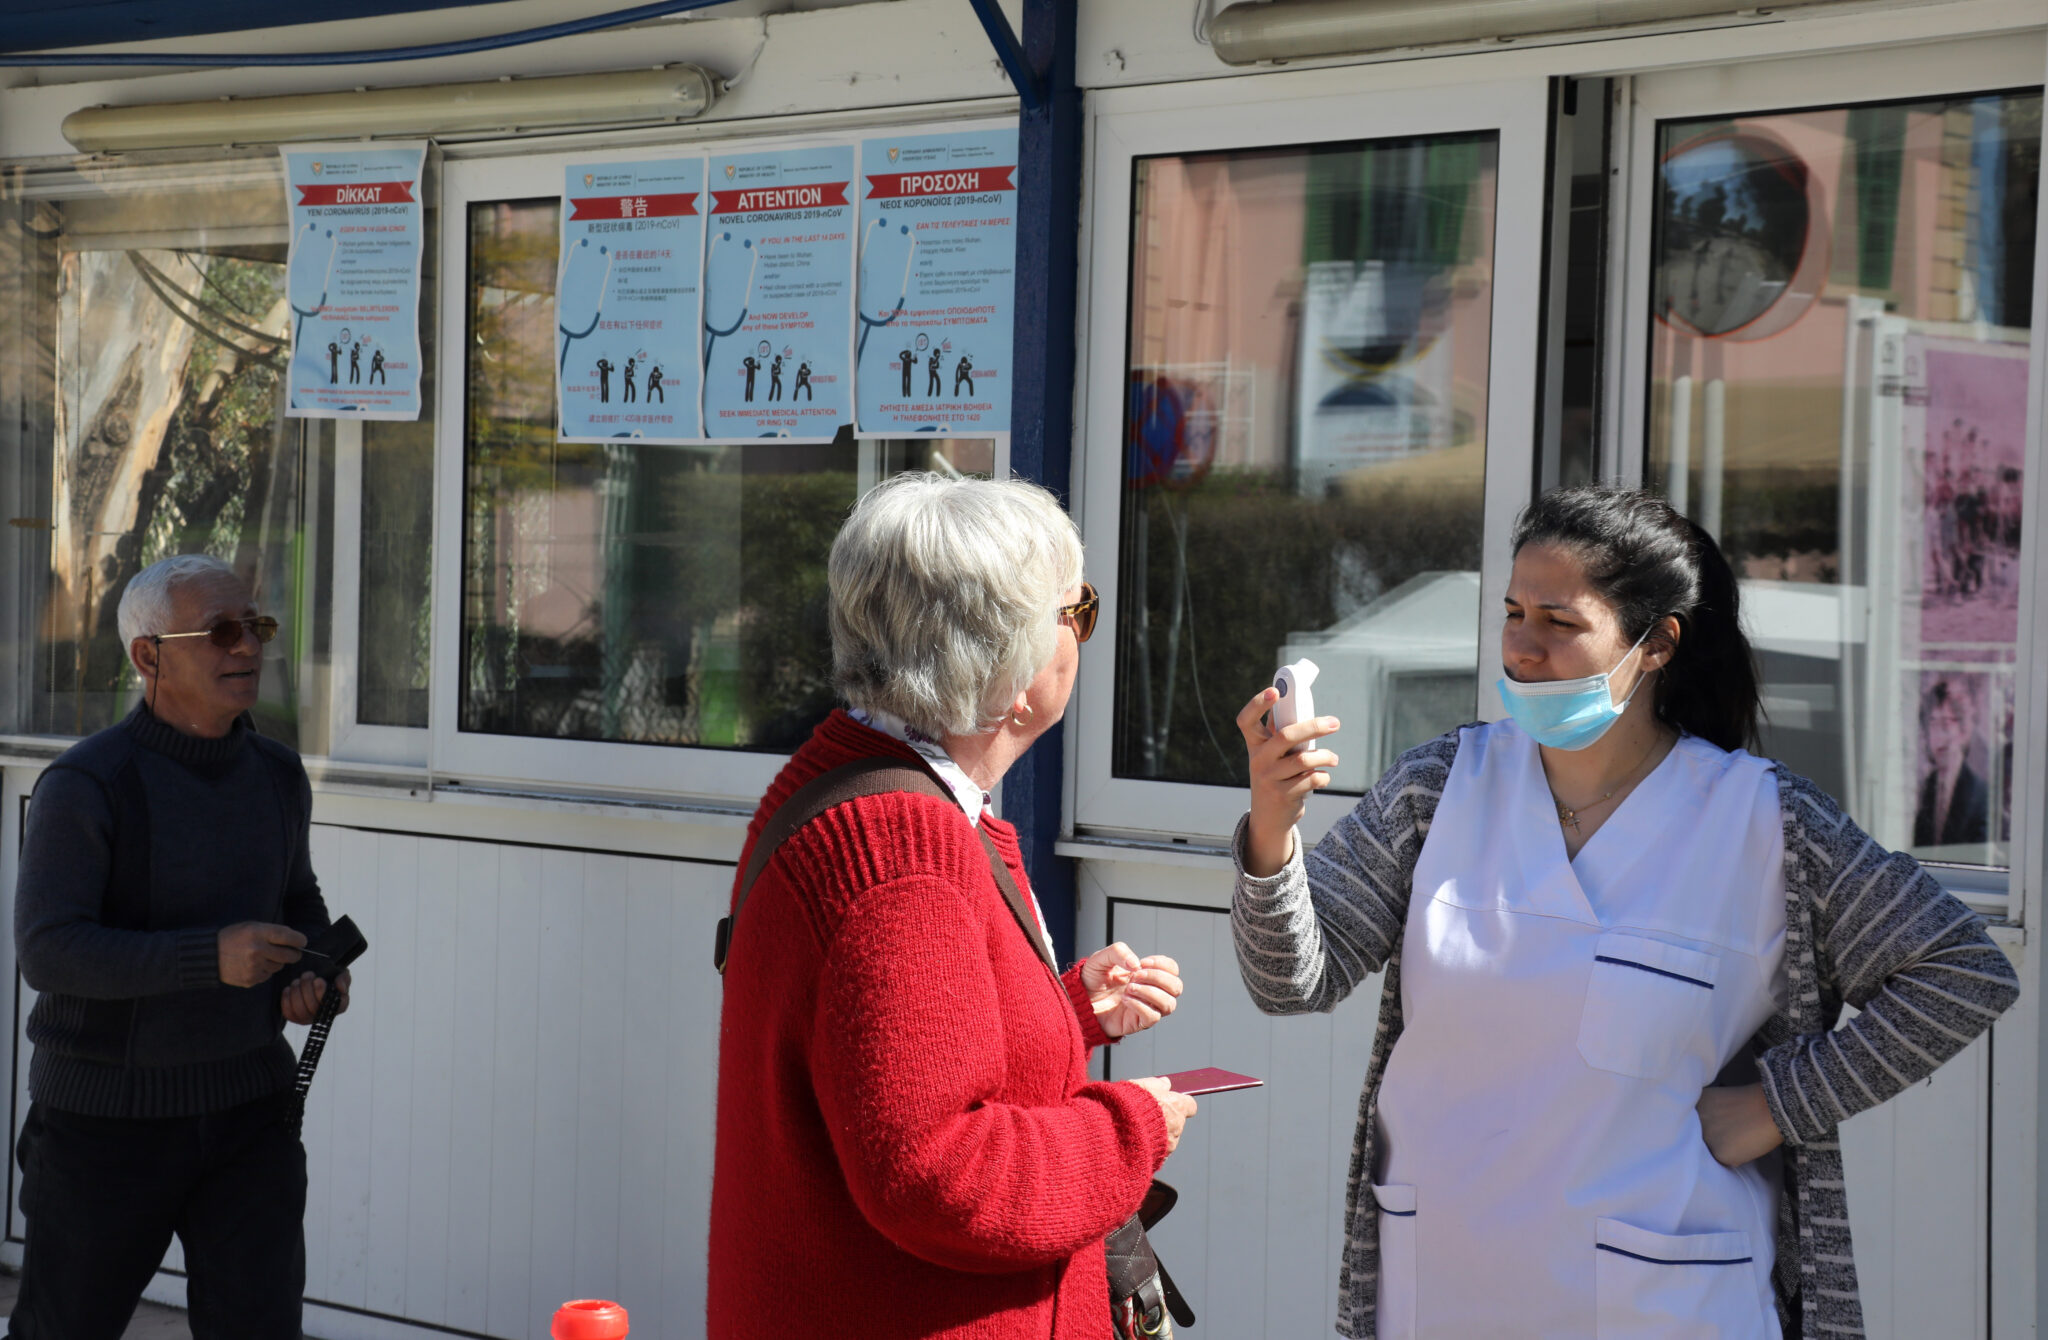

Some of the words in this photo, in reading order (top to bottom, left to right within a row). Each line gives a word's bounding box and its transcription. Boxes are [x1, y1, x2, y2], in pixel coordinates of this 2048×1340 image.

[900, 172, 979, 194] ΠΡΟΣΟΧΗ
[336, 185, 381, 203] DİKKAT
[737, 187, 822, 210] ATTENTION
[880, 201, 902, 210] ΝΕΟΣ
[954, 193, 1002, 207] (2019-nCoV)
[620, 197, 648, 218] 警告
[719, 216, 745, 225] NOVEL
[746, 211, 802, 223] CORONAVIRUS
[803, 208, 843, 220] 2019-nCoV
[635, 218, 680, 231] (2019-nCoV)
[792, 236, 803, 244] THE
[804, 234, 820, 243] LAST
[762, 313, 778, 321] NOW
[779, 311, 809, 320] DEVELOP
[754, 323, 761, 331] of
[761, 323, 779, 331] these
[780, 321, 815, 330] SYMPTOMS
[719, 410, 736, 418] SEEK
[737, 409, 770, 417] IMMEDIATE
[771, 408, 799, 417] MEDICAL
[800, 408, 837, 416] ATTENTION
[767, 419, 782, 427] RING
[783, 419, 798, 427] 1420
